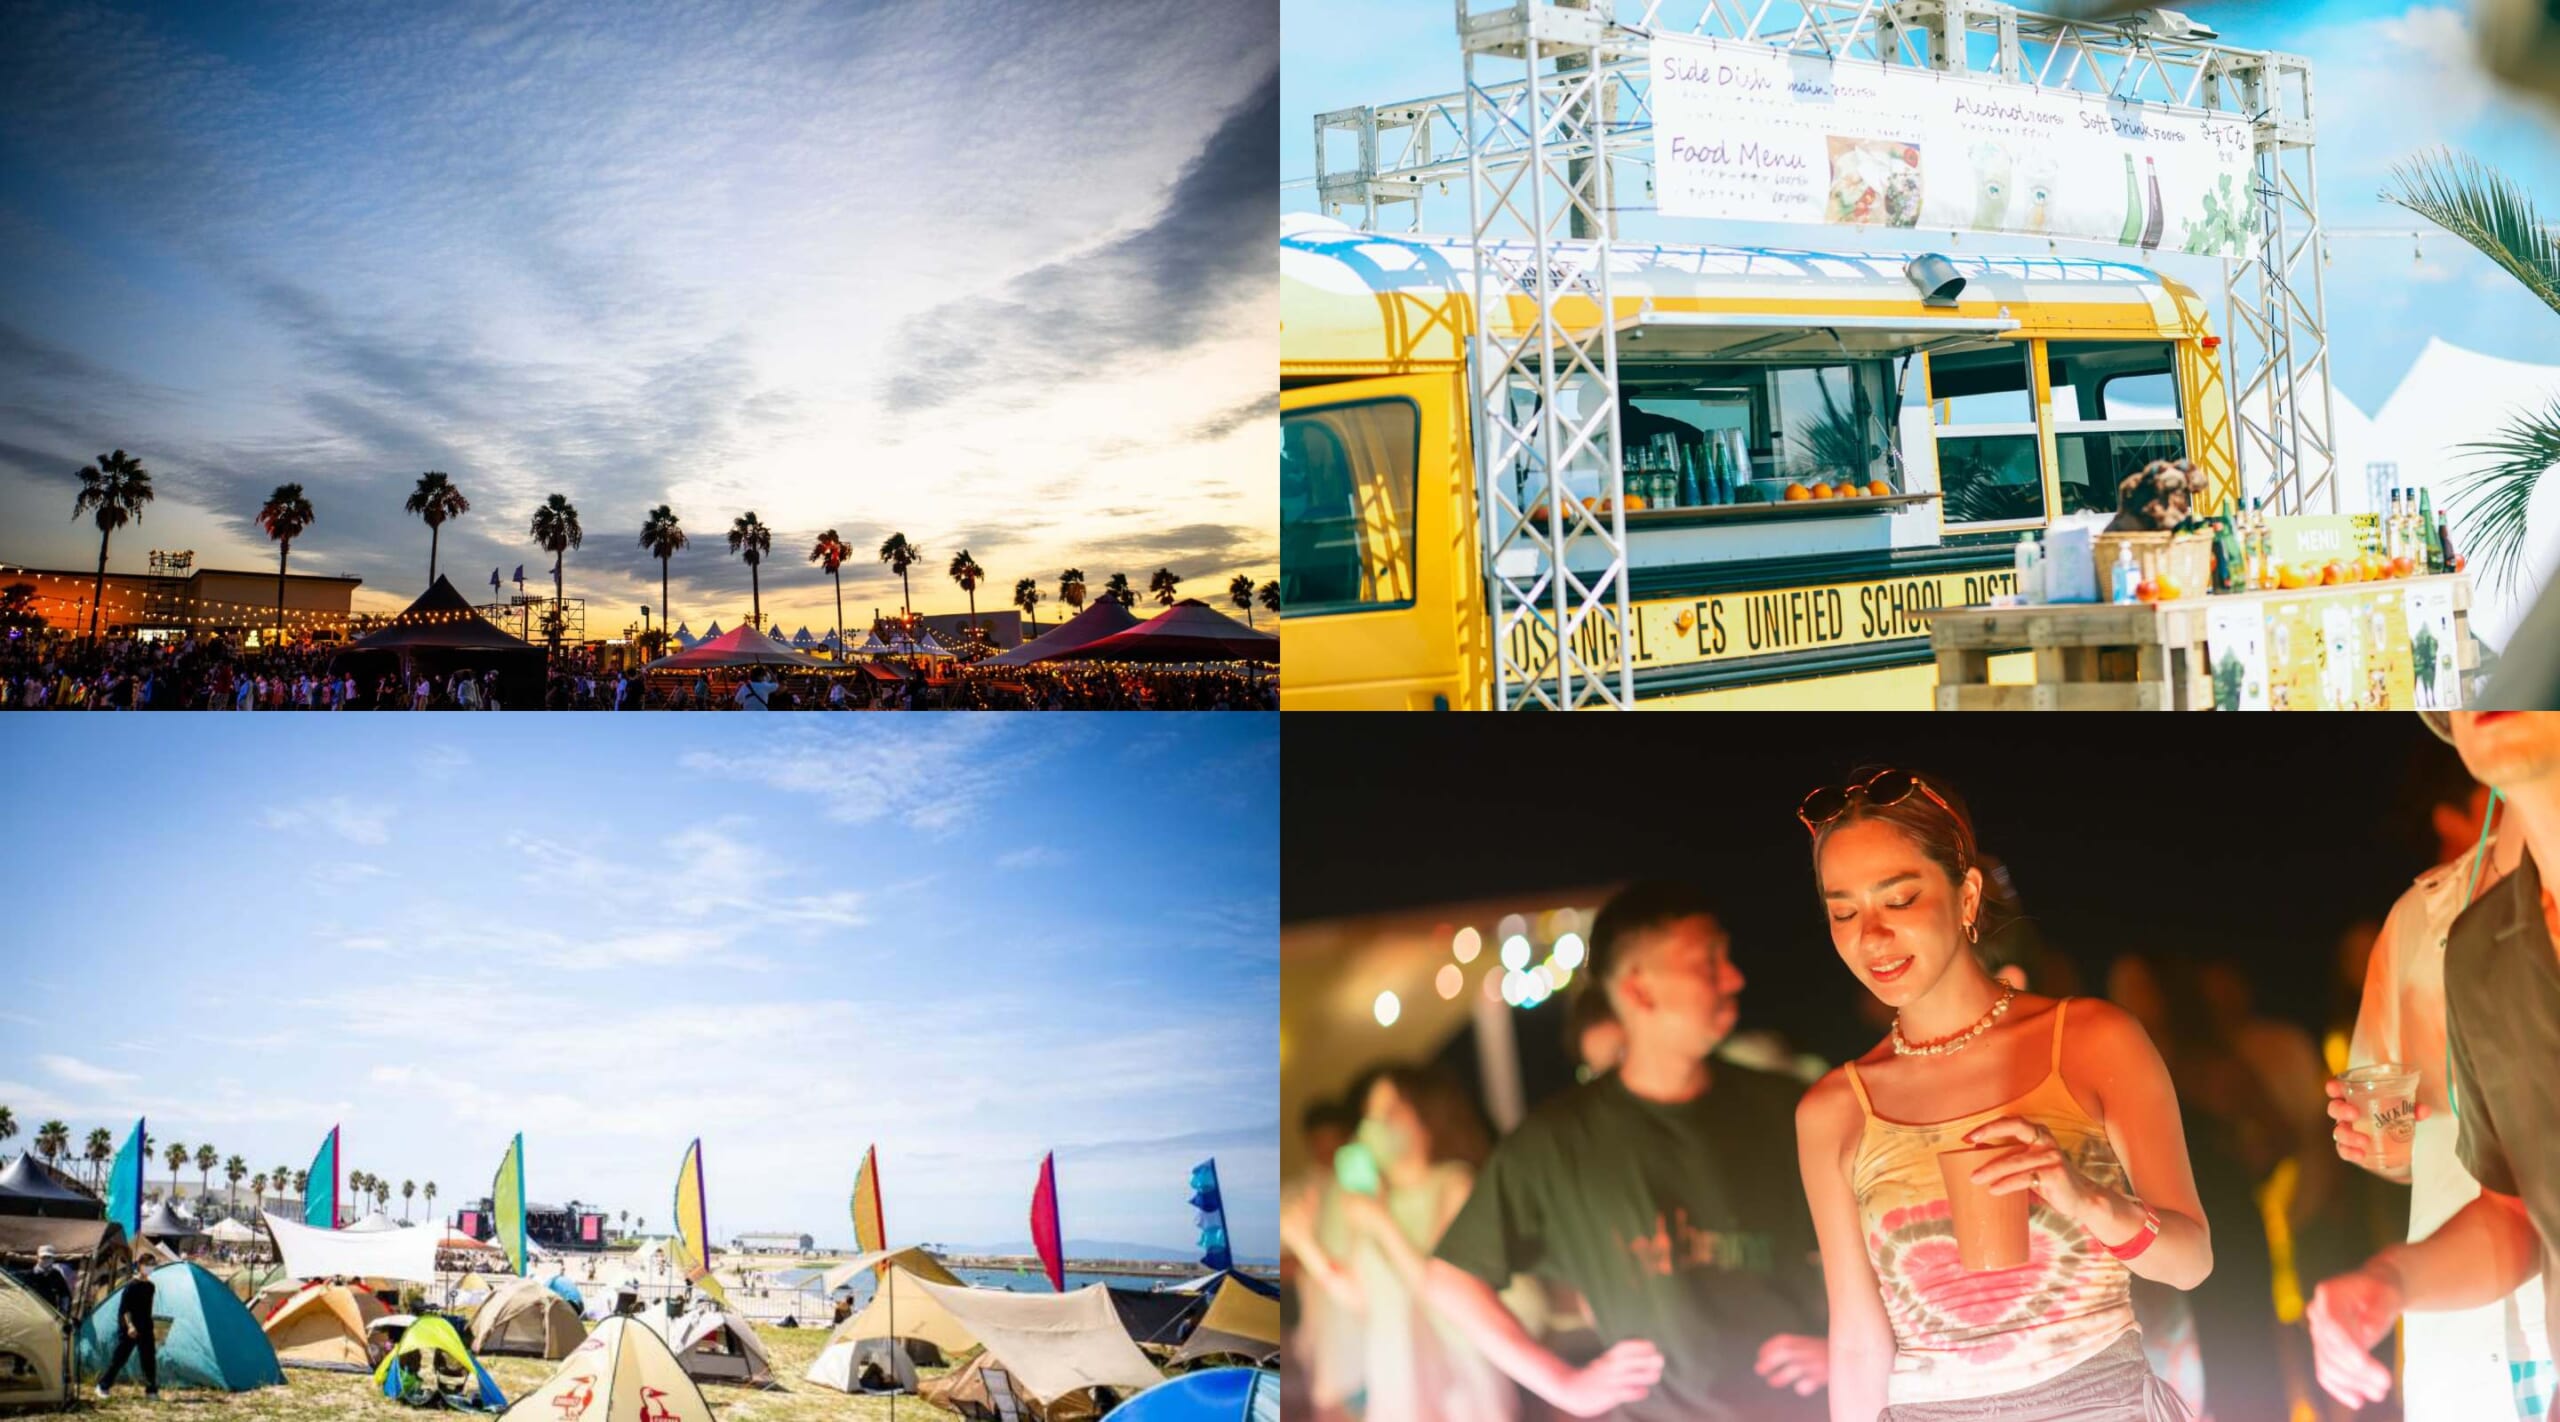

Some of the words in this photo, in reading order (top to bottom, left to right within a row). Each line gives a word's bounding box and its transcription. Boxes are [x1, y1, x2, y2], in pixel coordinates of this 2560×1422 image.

[1663, 57, 1710, 84] Side
[1718, 65, 1772, 90] Dish
[1954, 96, 2029, 122] Alcohol
[2079, 111, 2108, 135] Soft
[2111, 117, 2153, 138] Drink
[1671, 137, 1730, 165] Food
[1738, 142, 1806, 169] Menu
[2297, 528, 2340, 551] MENU
[1504, 615, 1550, 676] OS
[1698, 599, 1727, 655] ES
[1745, 586, 1844, 651] UNIFIED
[1964, 572, 2018, 606] DIST
